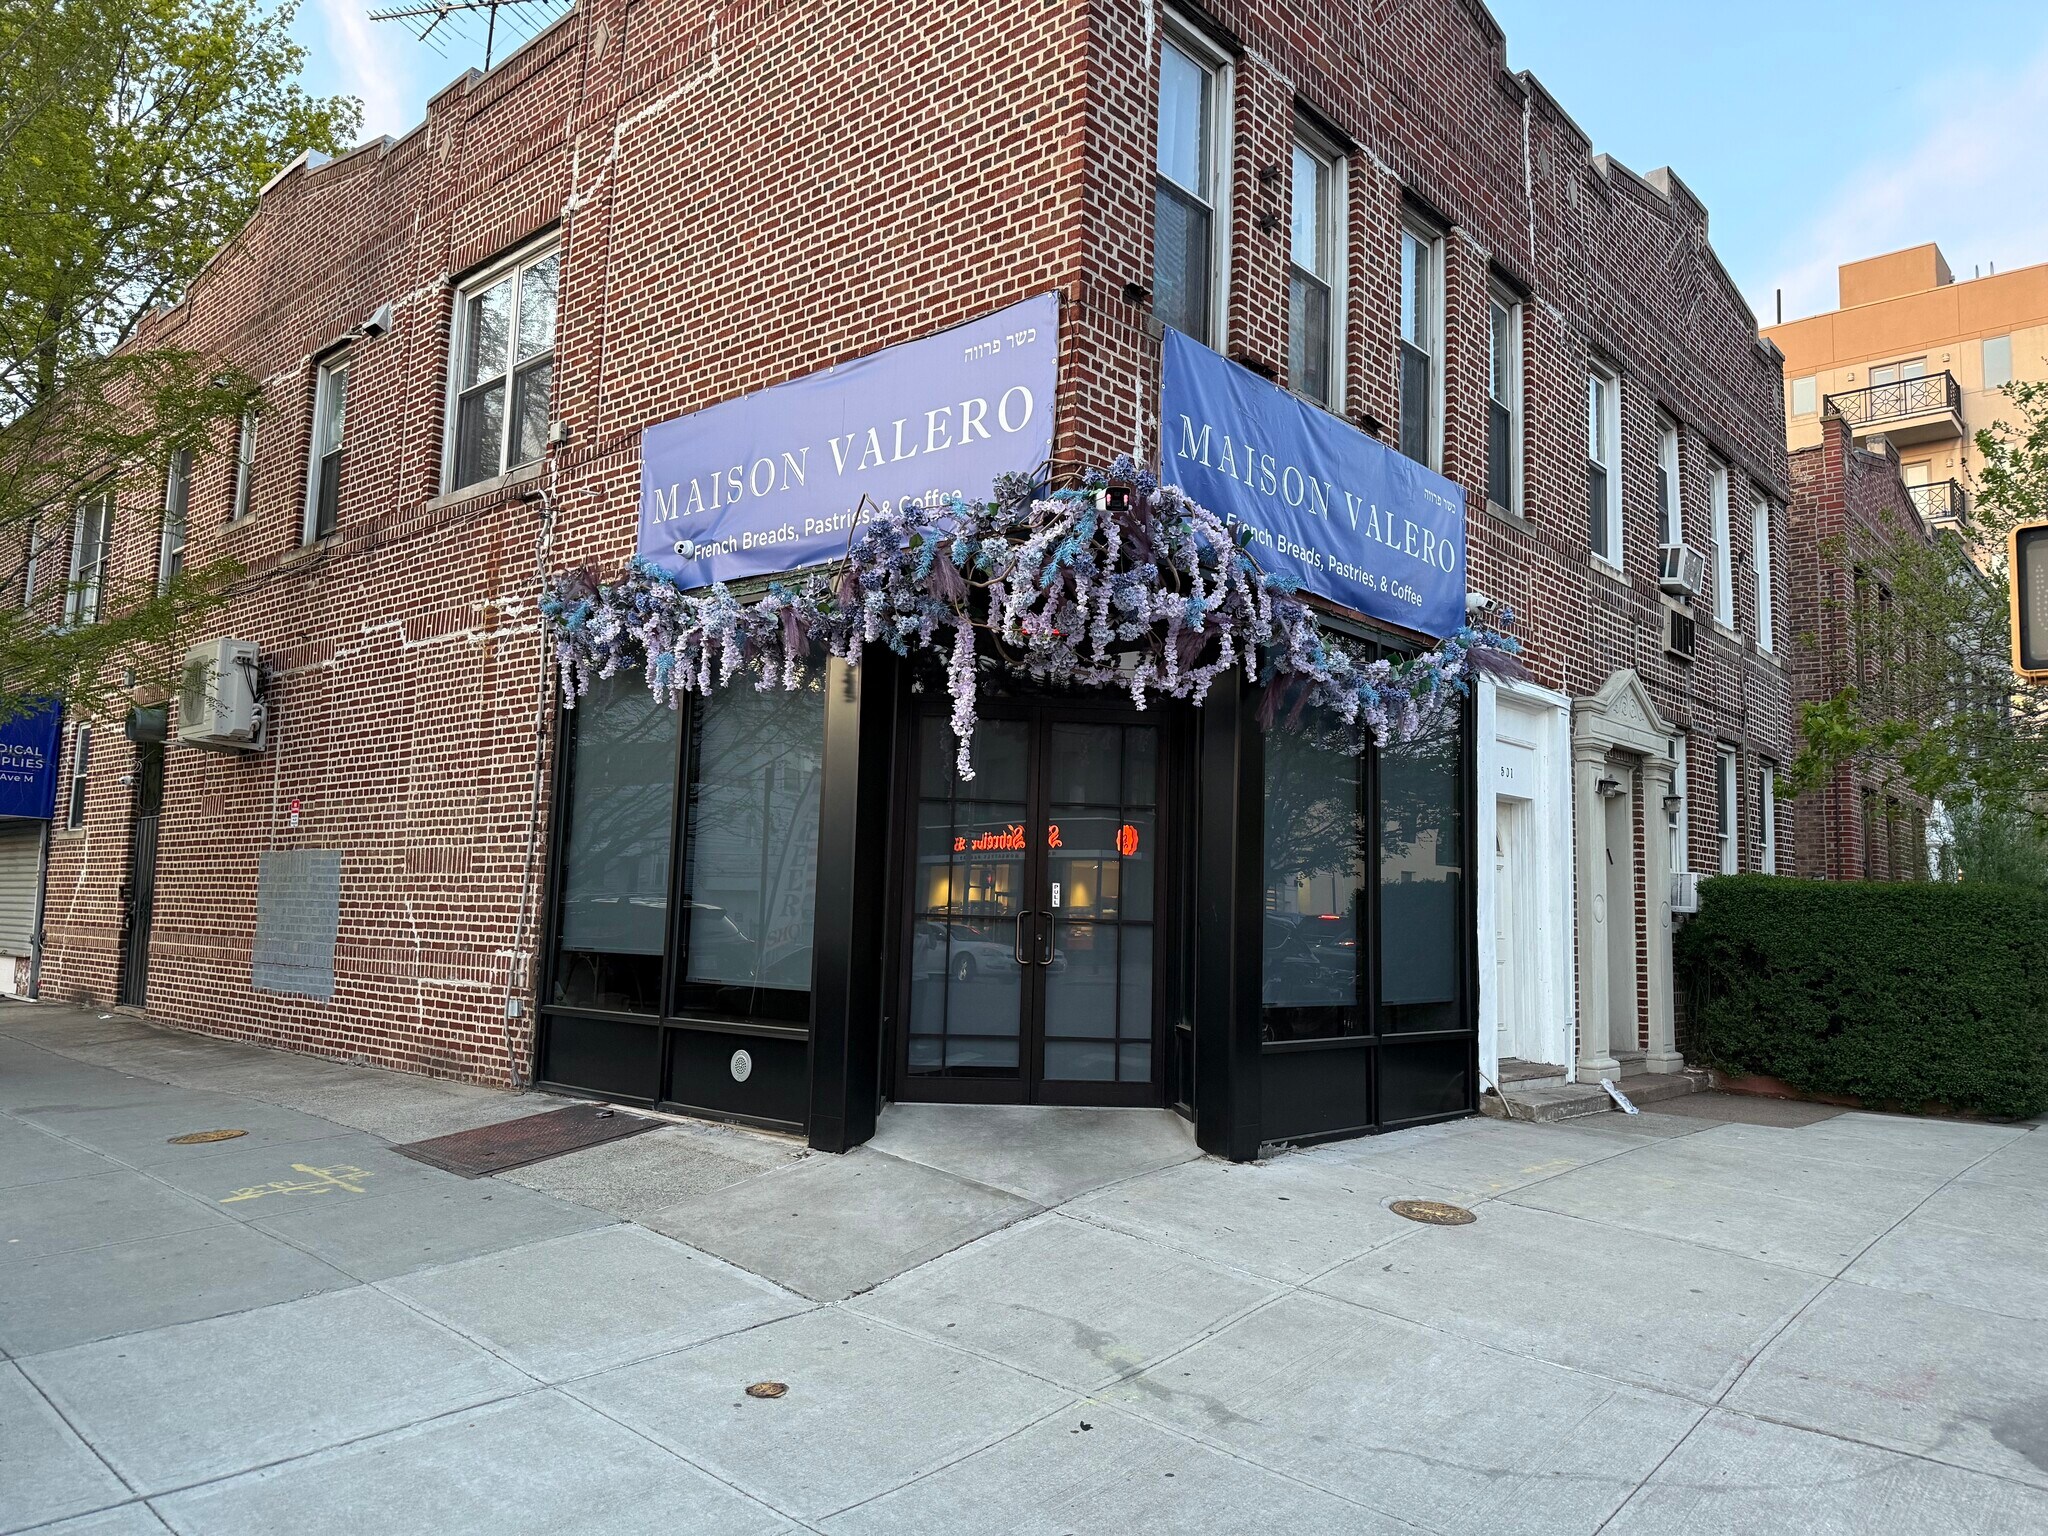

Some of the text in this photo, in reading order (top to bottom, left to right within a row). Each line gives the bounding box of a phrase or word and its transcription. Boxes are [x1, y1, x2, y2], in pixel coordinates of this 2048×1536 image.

[964, 328, 1036, 363] כשר פרווה
[653, 385, 1035, 525] MAISON VALERO
[1178, 413, 1455, 573] MAISON VALERO
[694, 535, 737, 562] French
[742, 523, 799, 549] Breads,
[1277, 533, 1324, 572] Breads,
[1328, 554, 1377, 591] Pastries,
[1380, 575, 1388, 593] &
[1390, 579, 1423, 607] Coffee
[0, 773, 34, 783] Ave M
